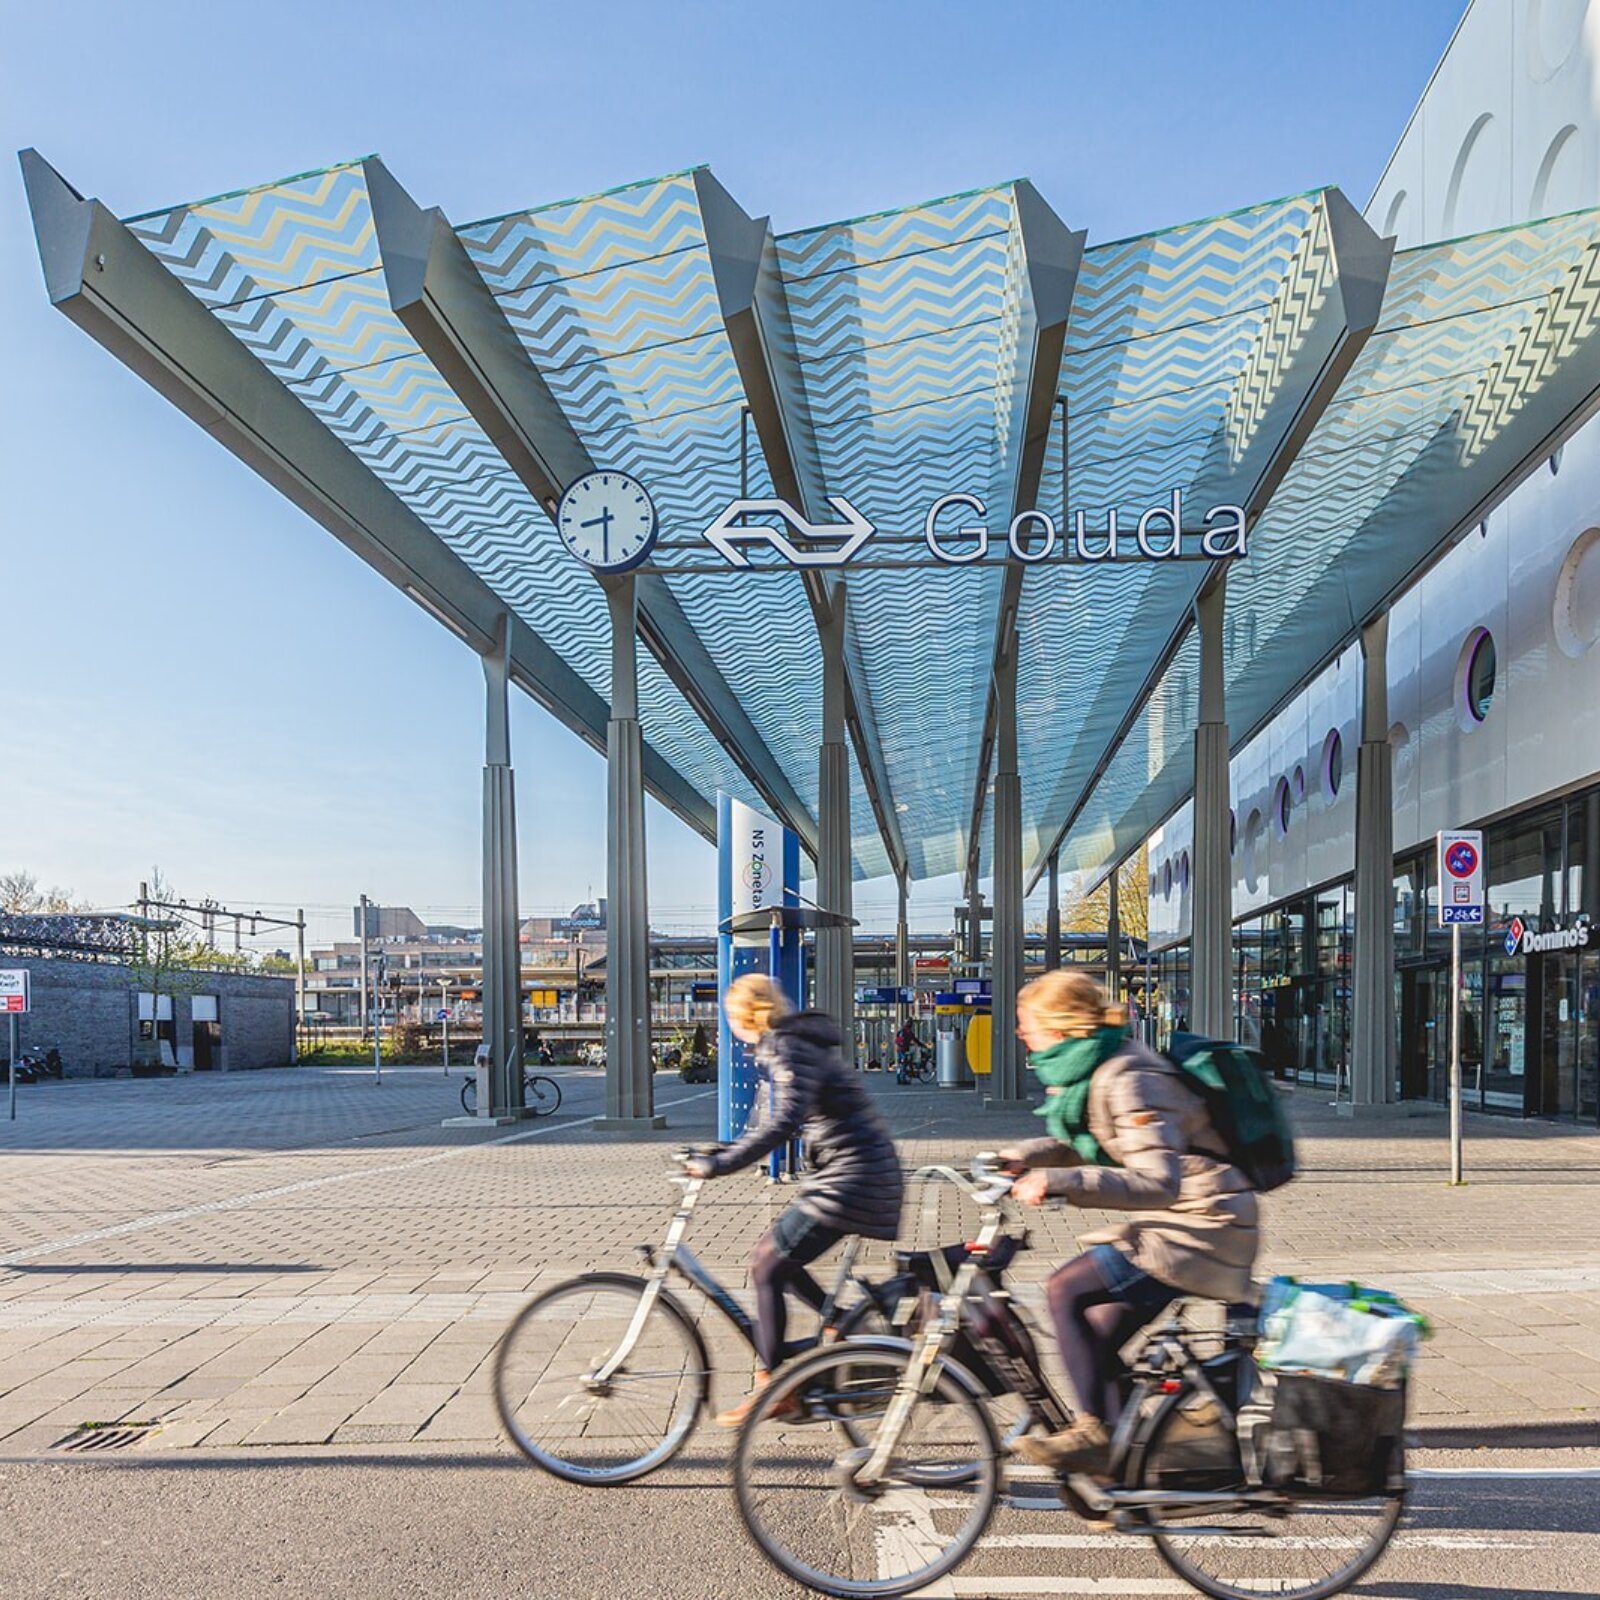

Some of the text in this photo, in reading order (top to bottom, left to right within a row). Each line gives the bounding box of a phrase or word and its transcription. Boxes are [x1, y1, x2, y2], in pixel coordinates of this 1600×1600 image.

[924, 488, 1248, 563] Gouda
[752, 830, 764, 849] NS
[1443, 908, 1454, 921] P
[1522, 920, 1589, 953] Domino's
